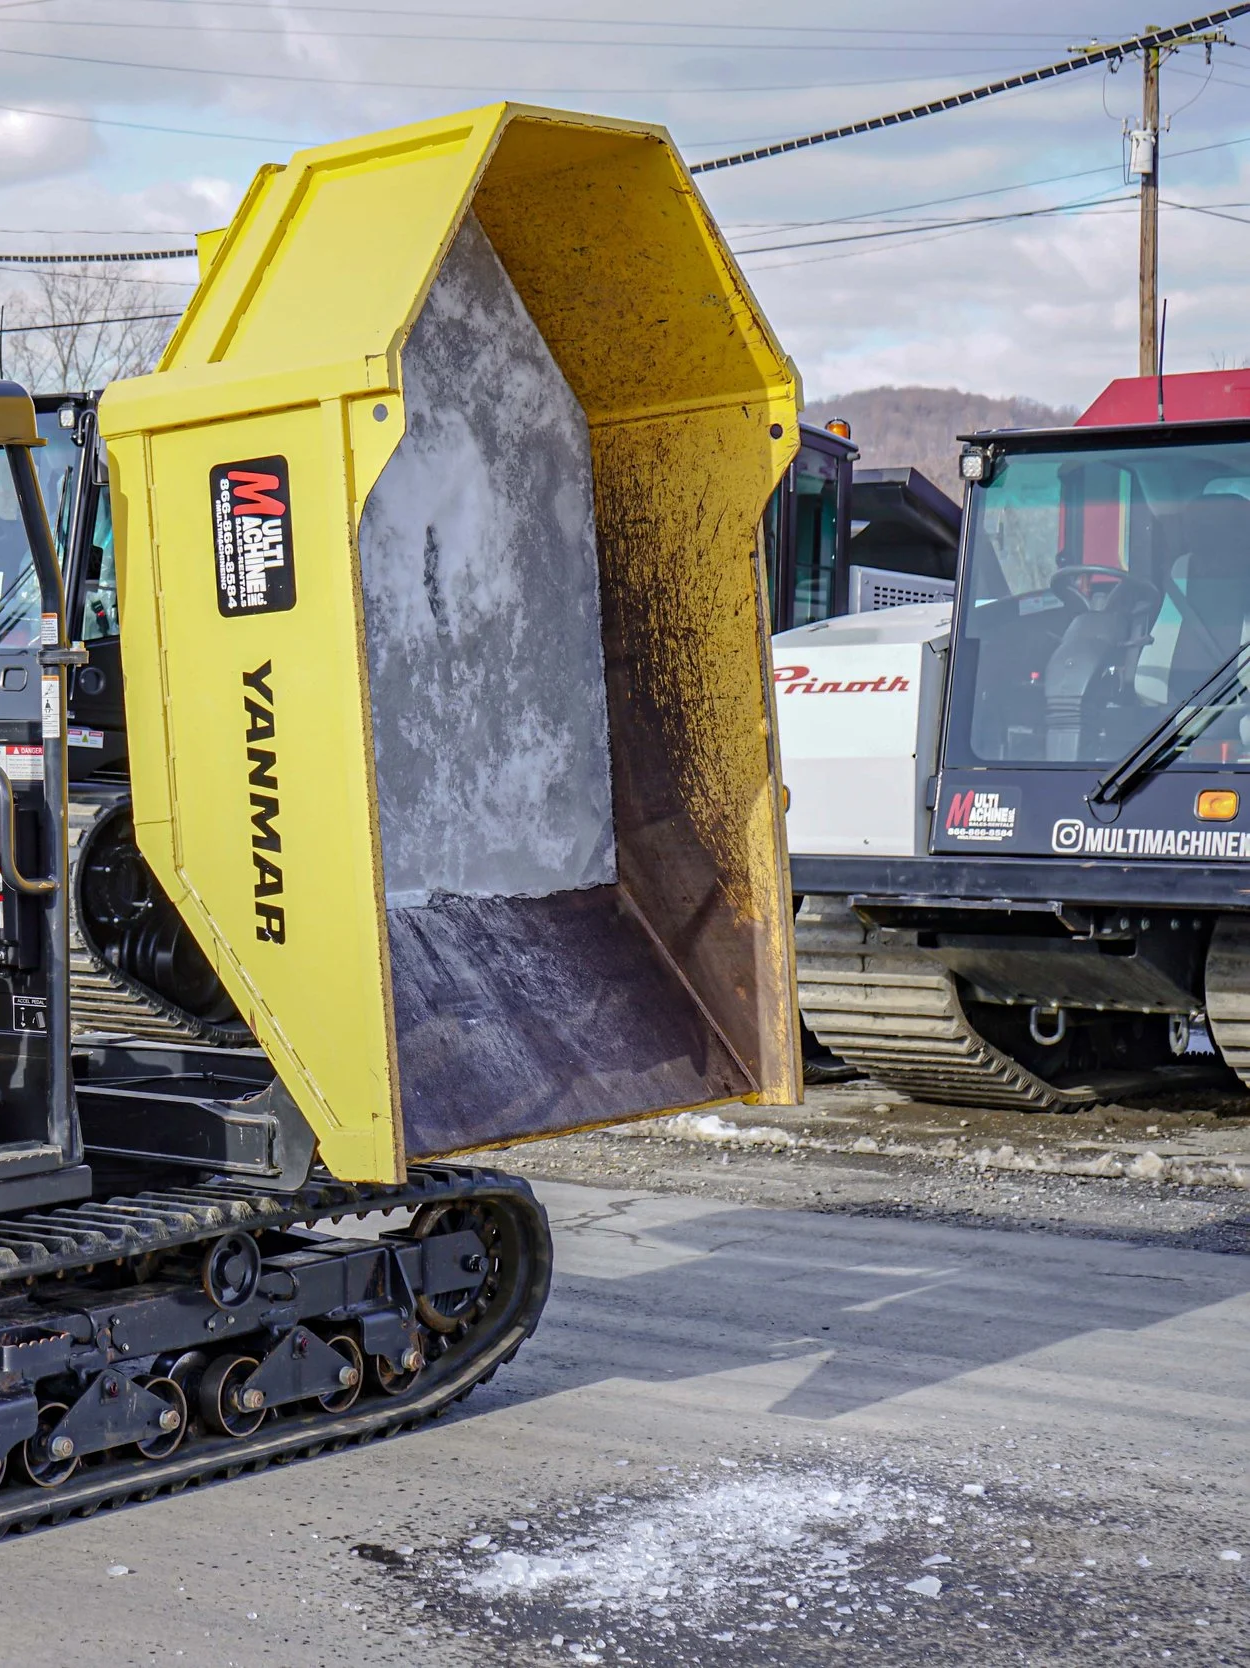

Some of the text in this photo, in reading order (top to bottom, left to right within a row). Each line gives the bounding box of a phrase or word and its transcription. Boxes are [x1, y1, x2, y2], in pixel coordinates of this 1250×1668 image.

[220, 478, 238, 609] 866-866-8584
[235, 517, 247, 608] SALES-RENTALS
[248, 593, 267, 606] INC.
[774, 666, 910, 694] Prinoth
[242, 659, 286, 945] YANMAR
[1084, 828, 1250, 858] MULTIMACHINEI
